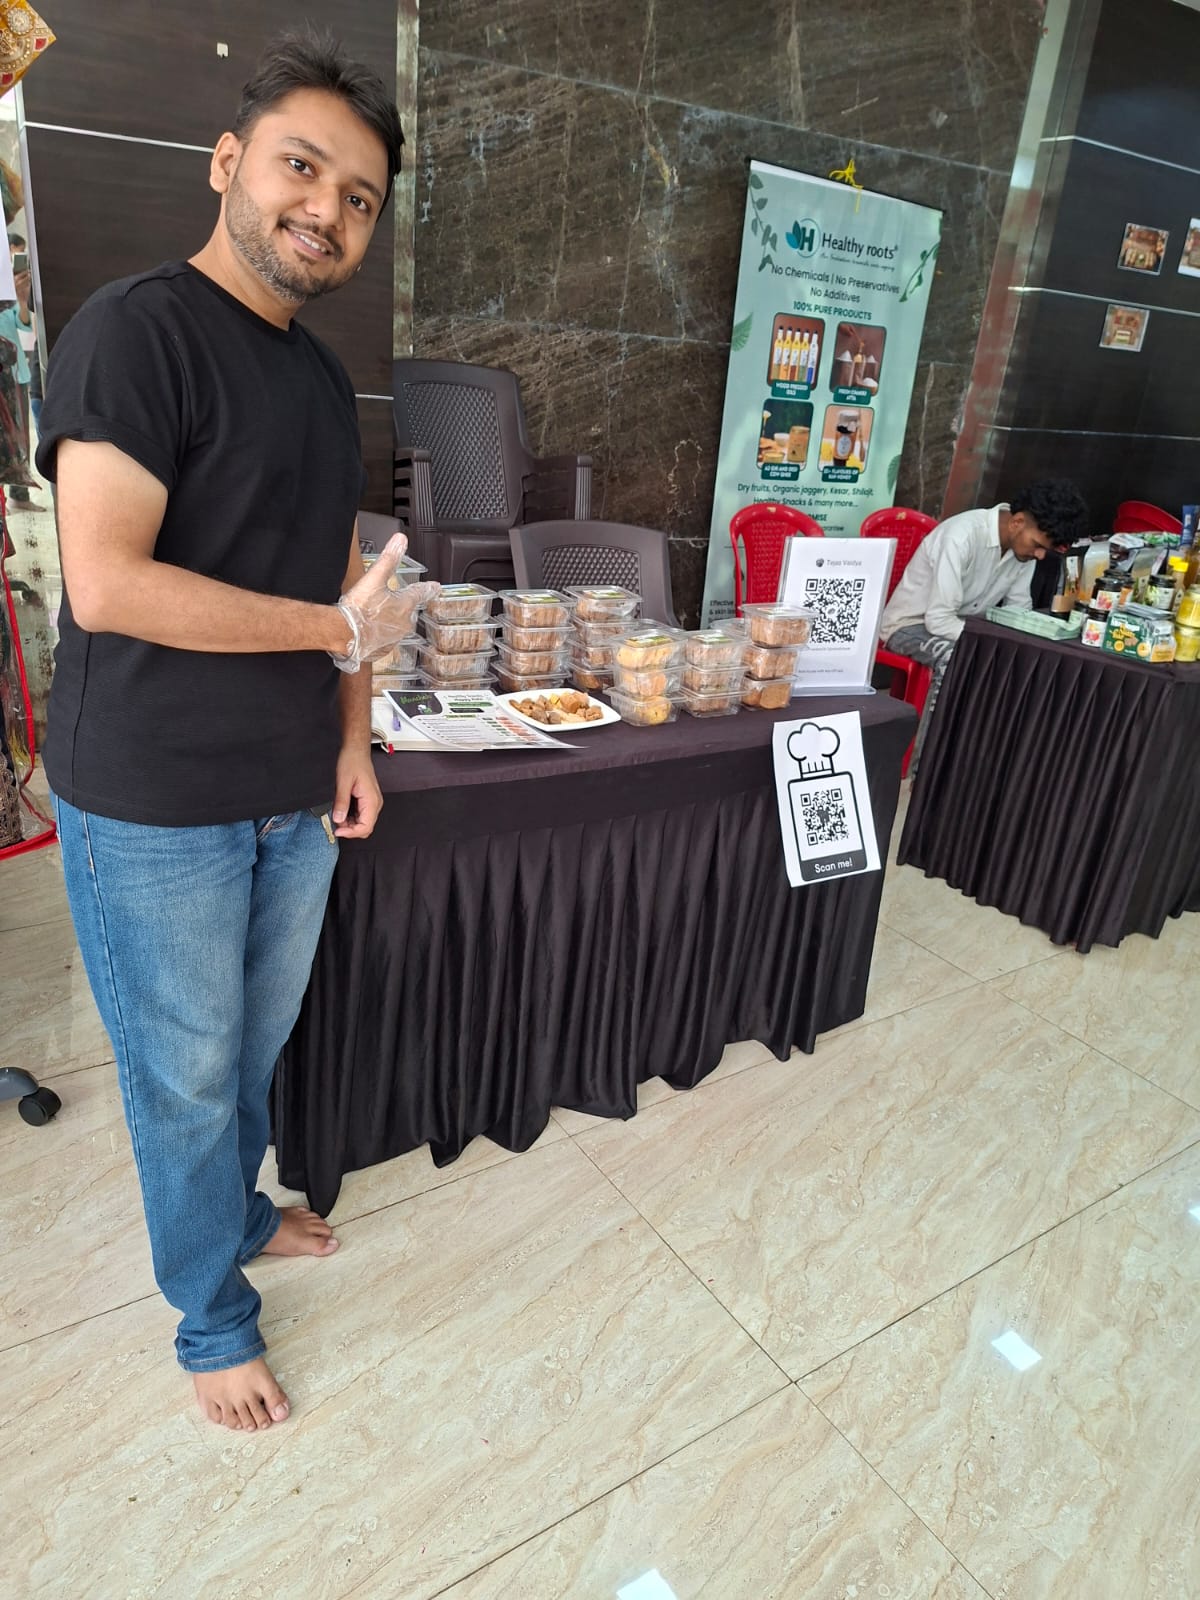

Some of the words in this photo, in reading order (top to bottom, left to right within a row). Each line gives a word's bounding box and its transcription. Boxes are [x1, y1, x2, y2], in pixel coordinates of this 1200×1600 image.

[822, 233, 864, 258] Healthy
[771, 265, 783, 276] No
[785, 266, 830, 283] Chemicals
[836, 275, 848, 286] No
[848, 277, 900, 294] Preservatives
[810, 287, 822, 297] No
[823, 289, 860, 303] Additives
[793, 301, 813, 313] 100%
[814, 304, 833, 315] PURE
[833, 307, 873, 320] PRODUCTS
[737, 483, 749, 494] Dry
[772, 484, 800, 495] Organic
[781, 497, 806, 506] Snacks
[807, 498, 813, 506] &
[814, 500, 833, 509] many
[814, 863, 836, 873] Scan
[837, 857, 853, 869] me!
